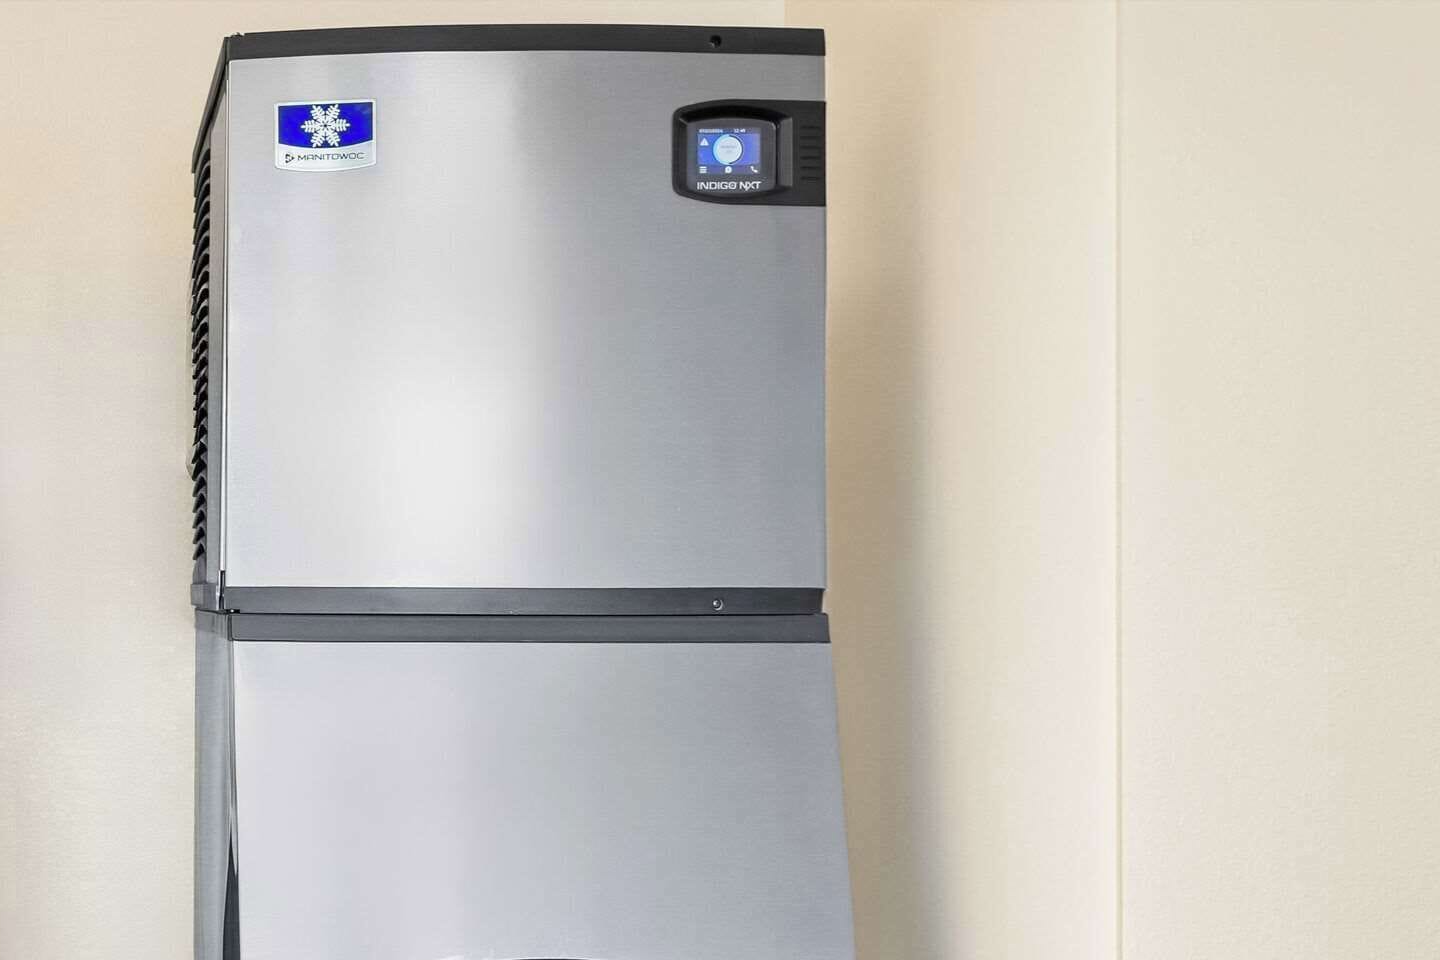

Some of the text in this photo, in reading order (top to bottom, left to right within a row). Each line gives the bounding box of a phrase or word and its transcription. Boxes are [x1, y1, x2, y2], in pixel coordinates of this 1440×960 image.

[297, 152, 365, 161] MANITOWOC
[696, 181, 762, 191] INDIGO NXT
